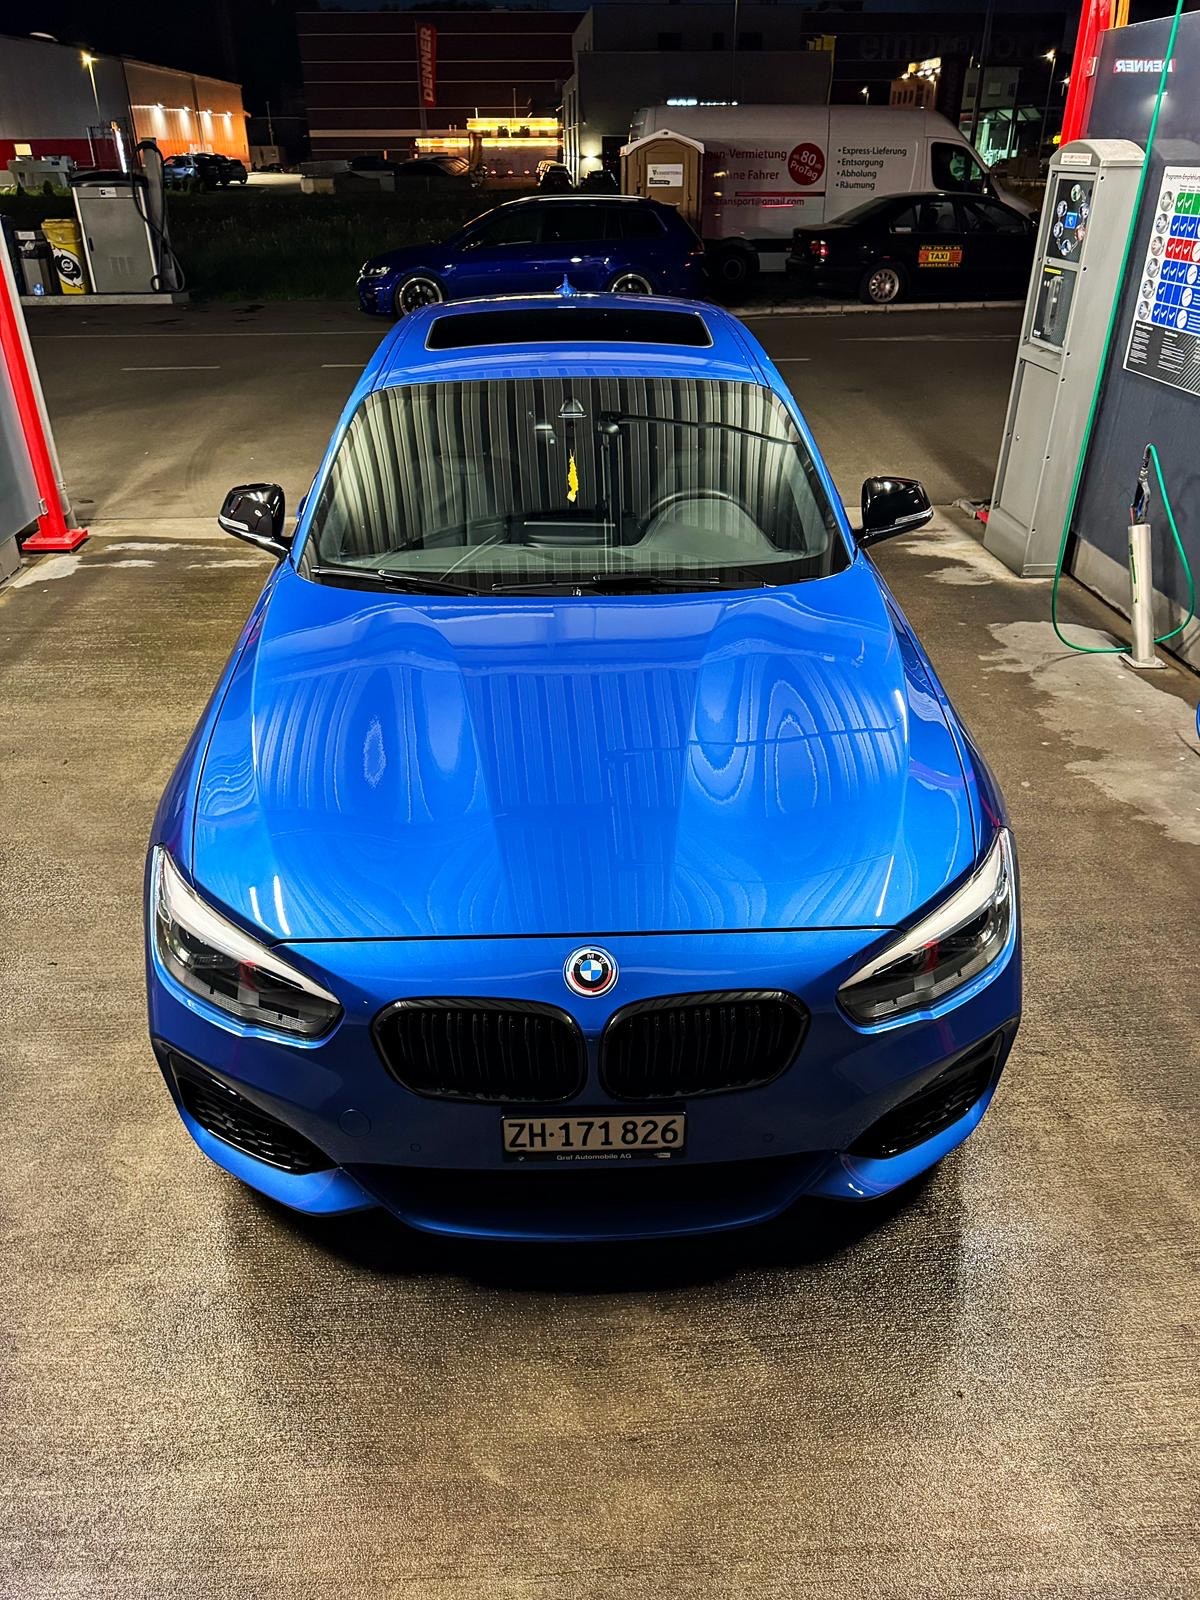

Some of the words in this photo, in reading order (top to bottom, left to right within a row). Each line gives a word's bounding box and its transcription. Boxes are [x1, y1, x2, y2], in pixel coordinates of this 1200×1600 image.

[420, 27, 433, 102] DENNER
[842, 147, 907, 156] Express-Lieferung
[800, 150, 817, 167] 80
[841, 158, 884, 168] Entsorgung
[748, 169, 780, 180] Fahrer
[790, 160, 818, 181] ProTag
[840, 170, 877, 179] Abholung
[840, 180, 875, 190] Räumung
[930, 252, 948, 260] TAXI
